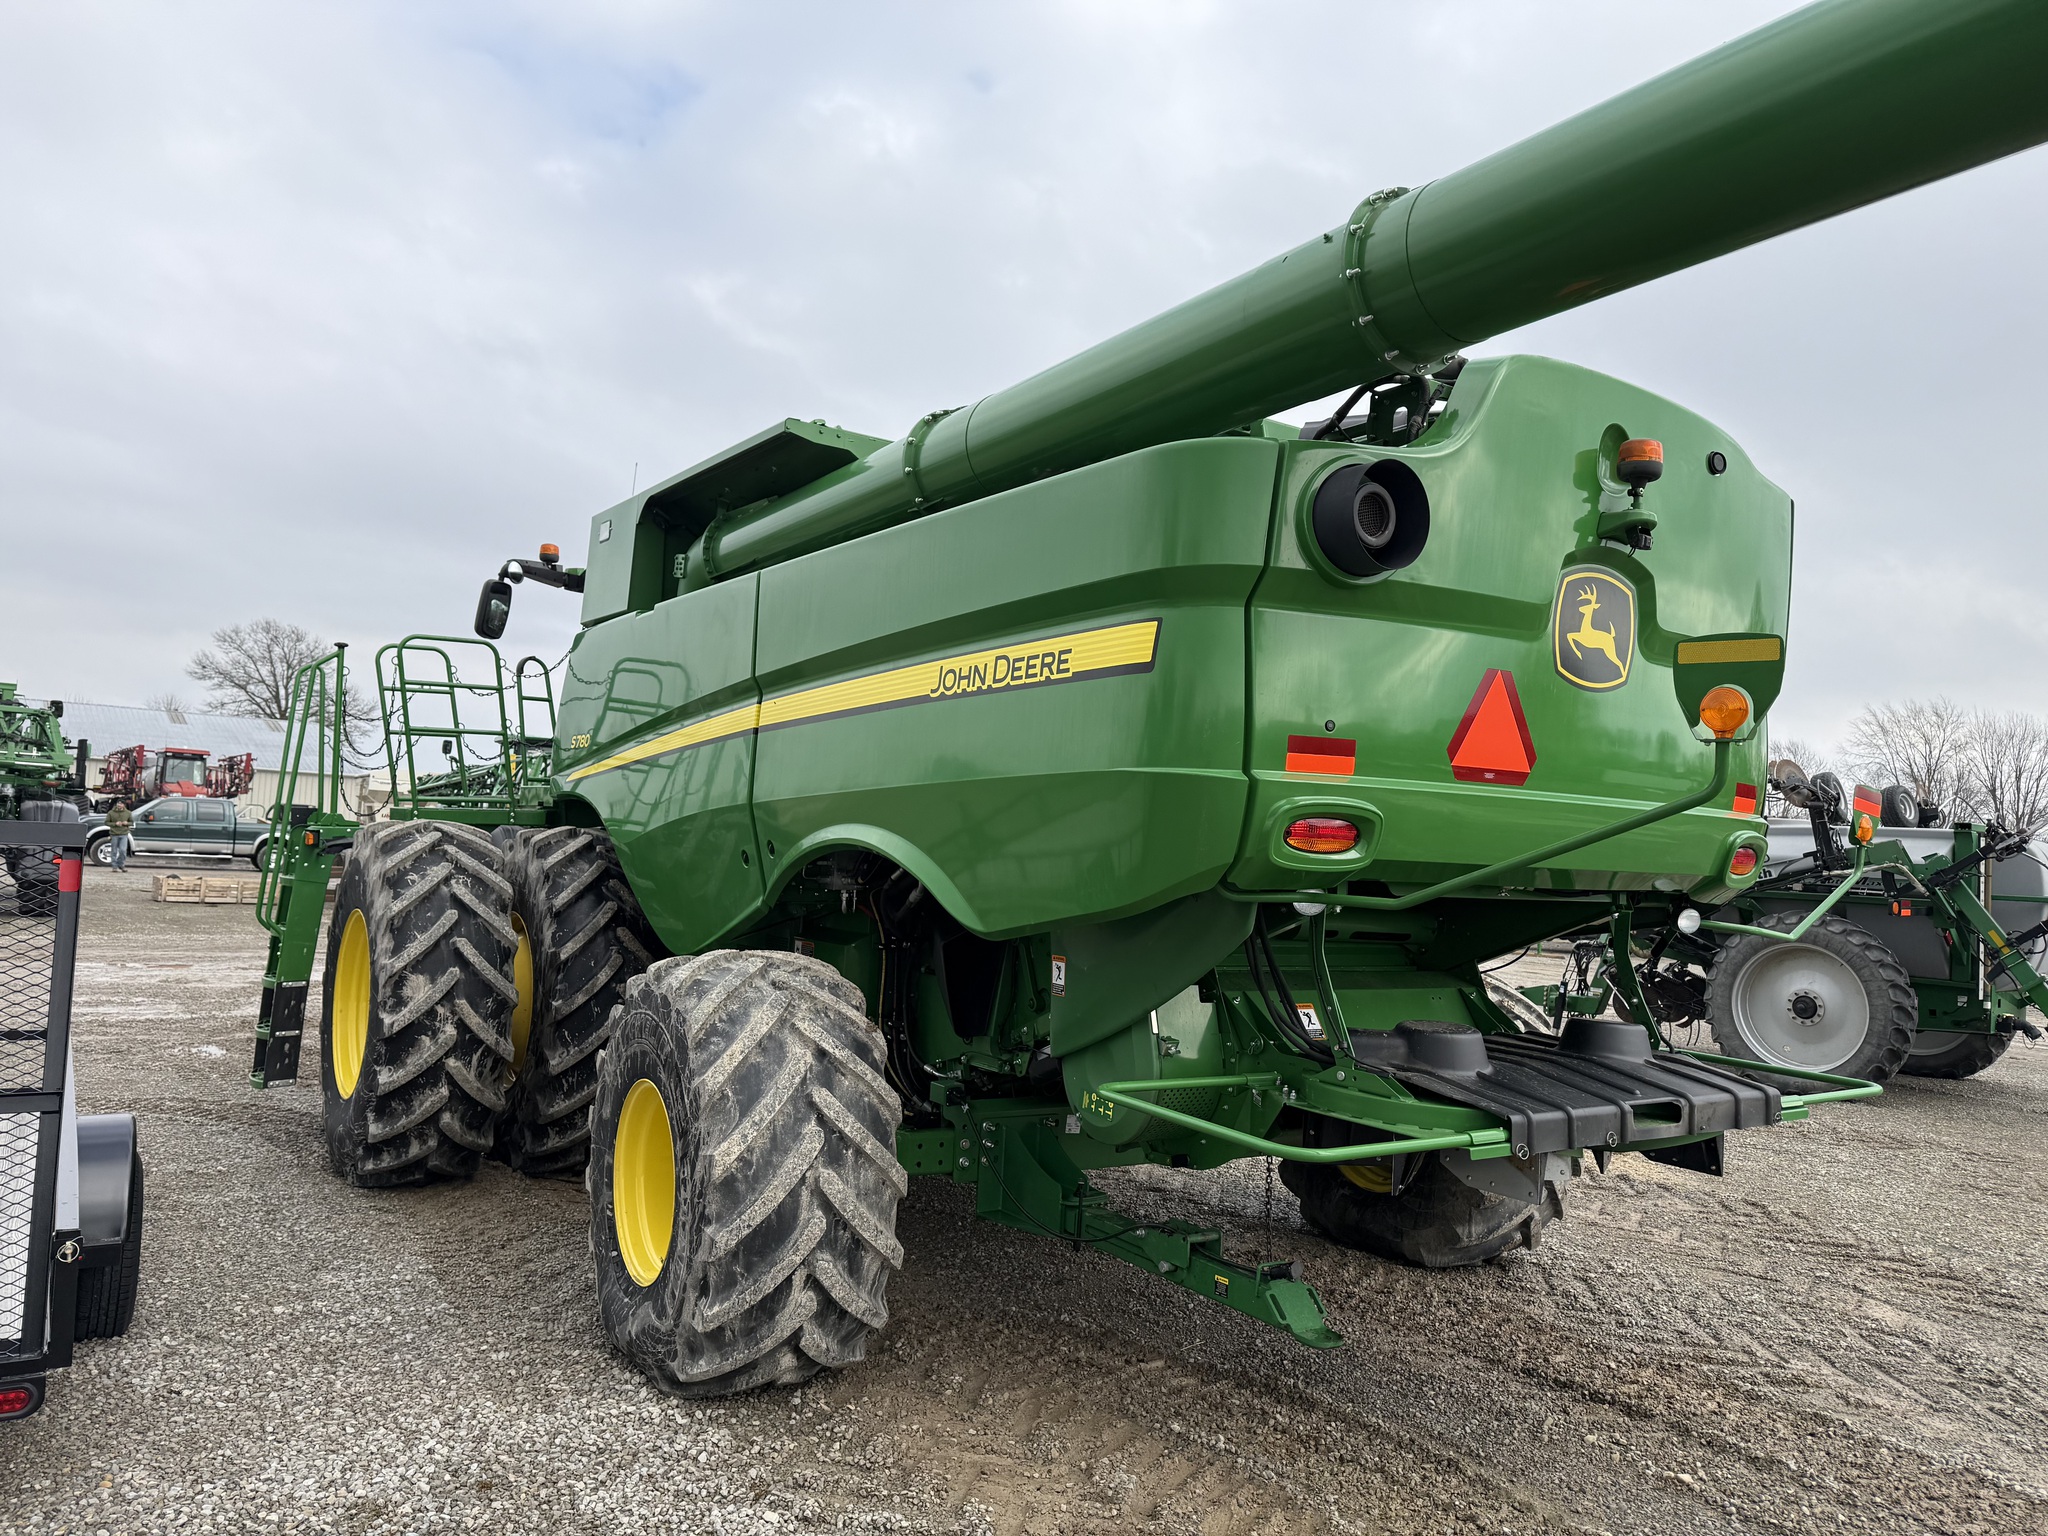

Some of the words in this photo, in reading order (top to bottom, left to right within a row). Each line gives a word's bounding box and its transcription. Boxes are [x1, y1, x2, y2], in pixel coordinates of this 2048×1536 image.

[930, 663, 988, 696] JOHN
[992, 648, 1073, 686] DEERE
[571, 734, 590, 749] S780
